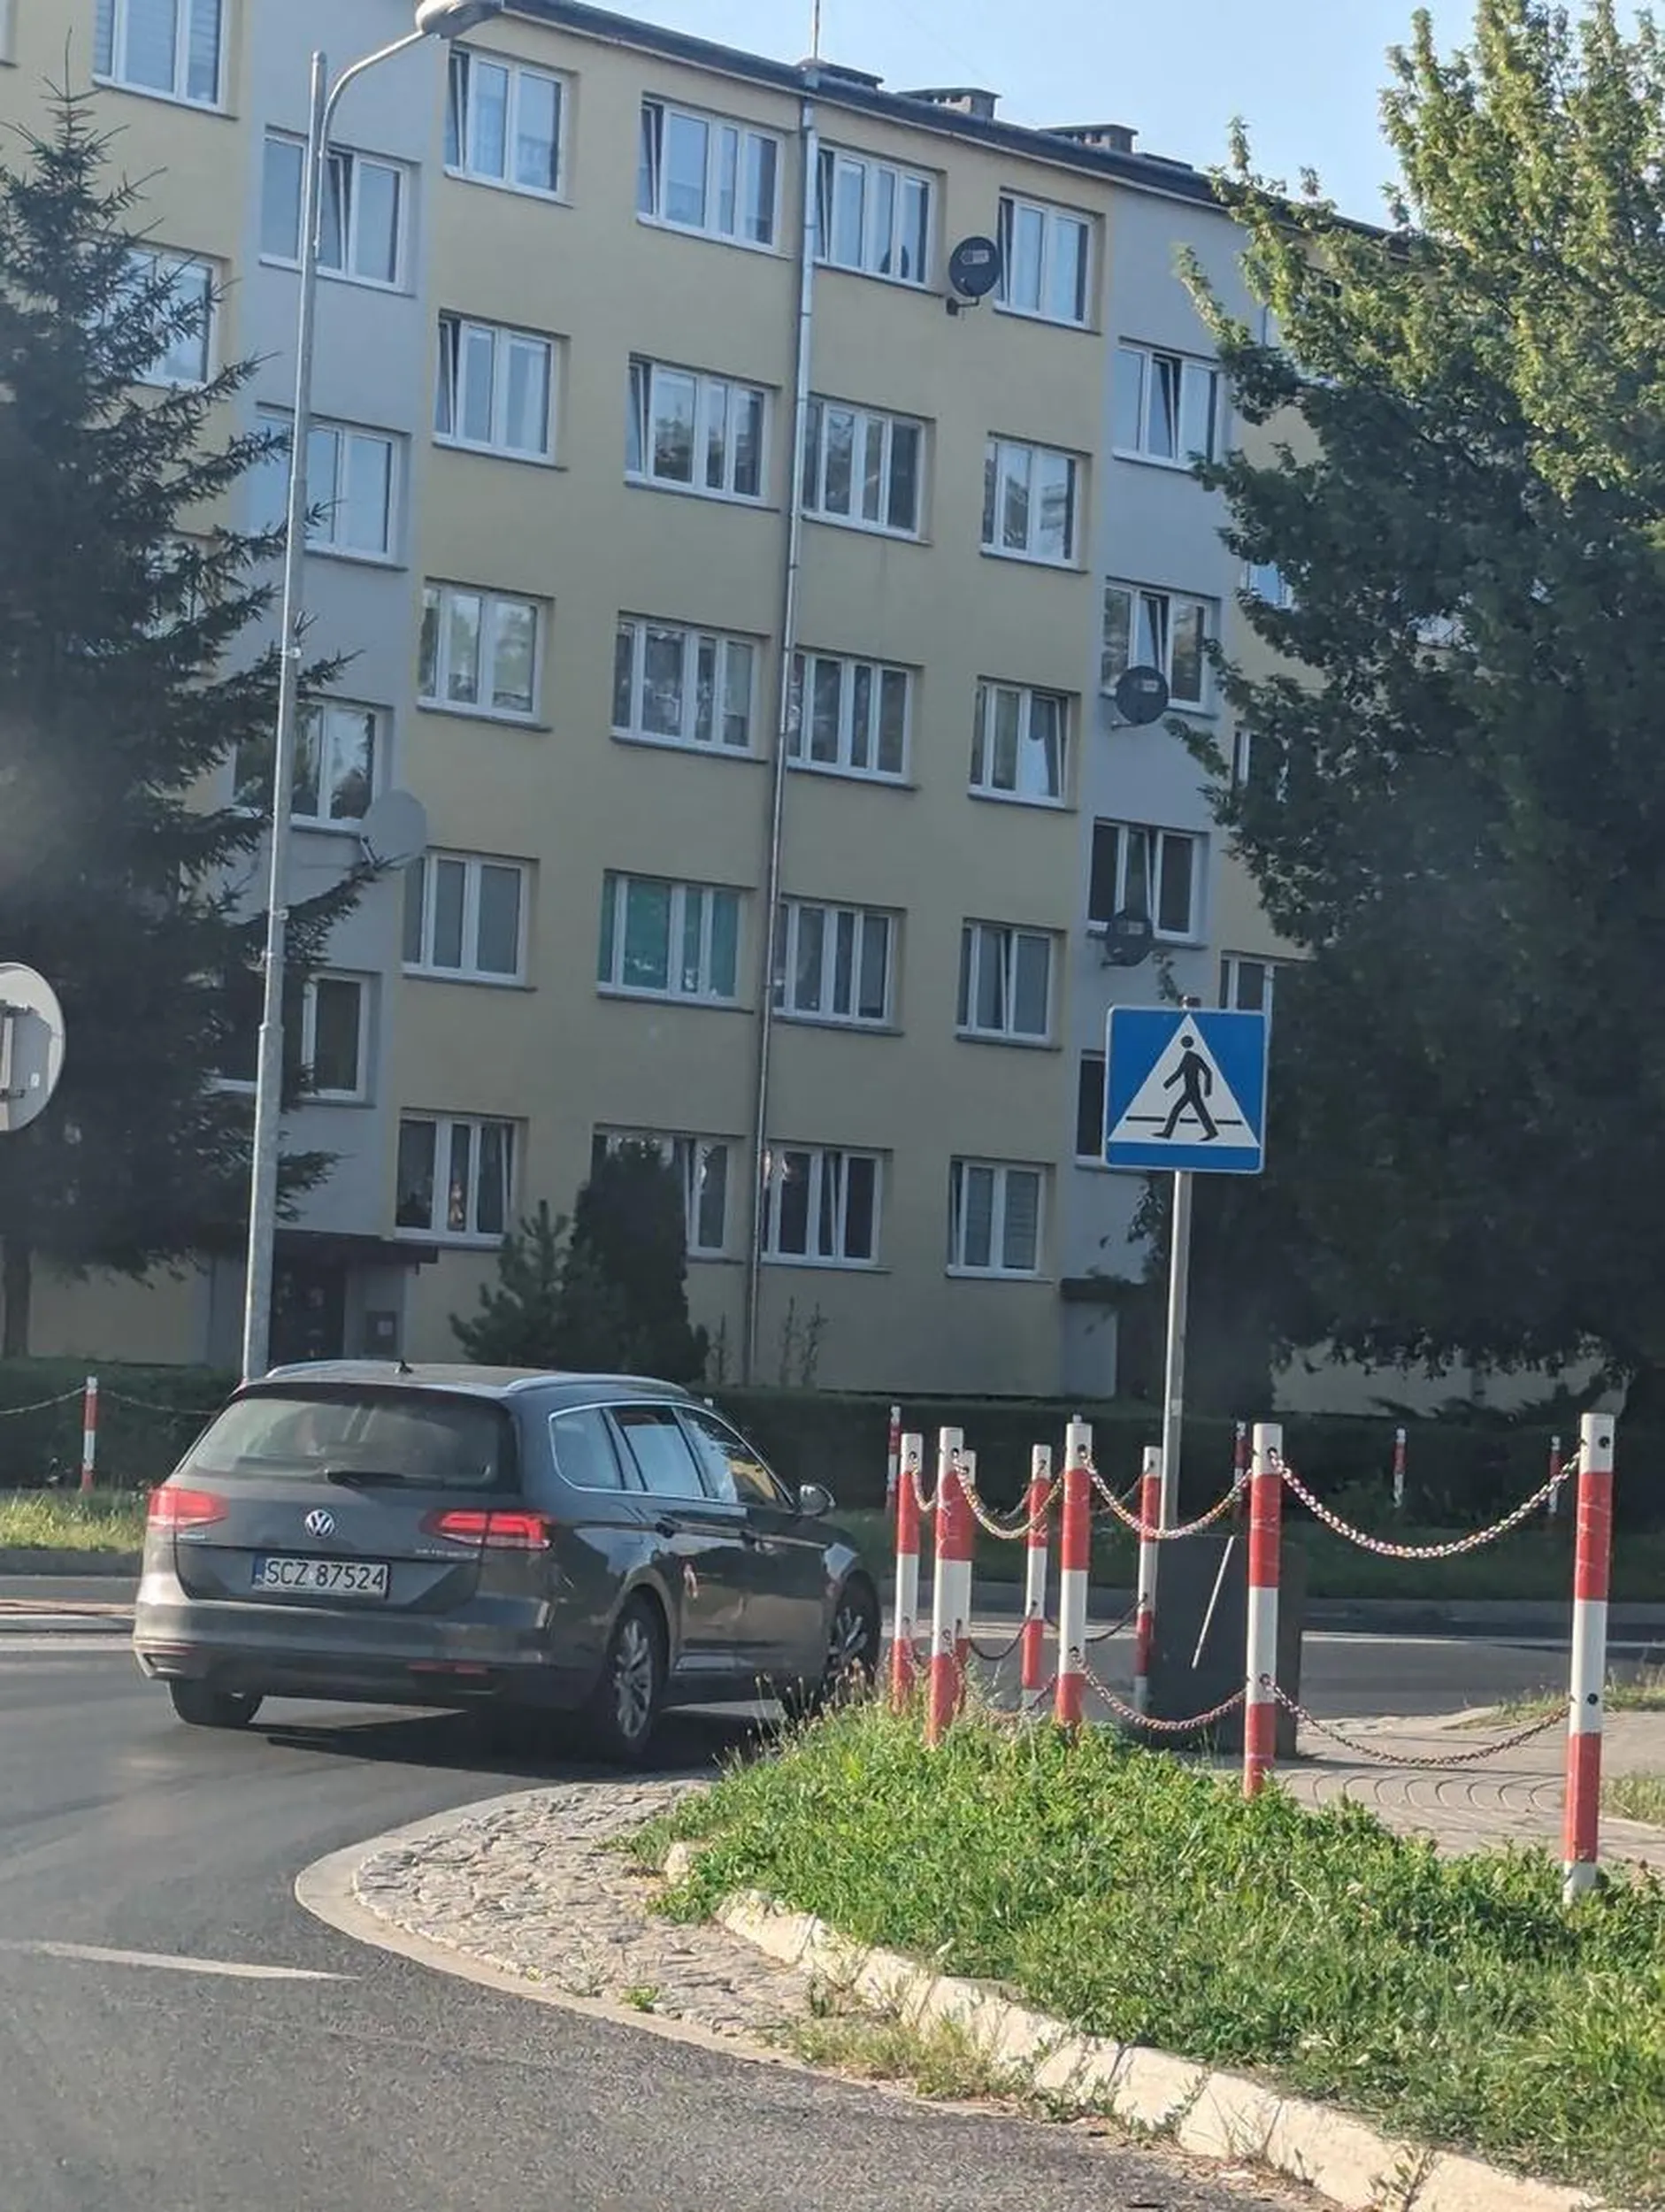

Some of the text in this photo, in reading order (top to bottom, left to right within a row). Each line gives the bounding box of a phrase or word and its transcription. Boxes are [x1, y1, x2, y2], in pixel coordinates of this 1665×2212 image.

[305, 1509, 334, 1539] VW
[266, 1560, 309, 1586] SCZ
[316, 1563, 386, 1590] 87524
